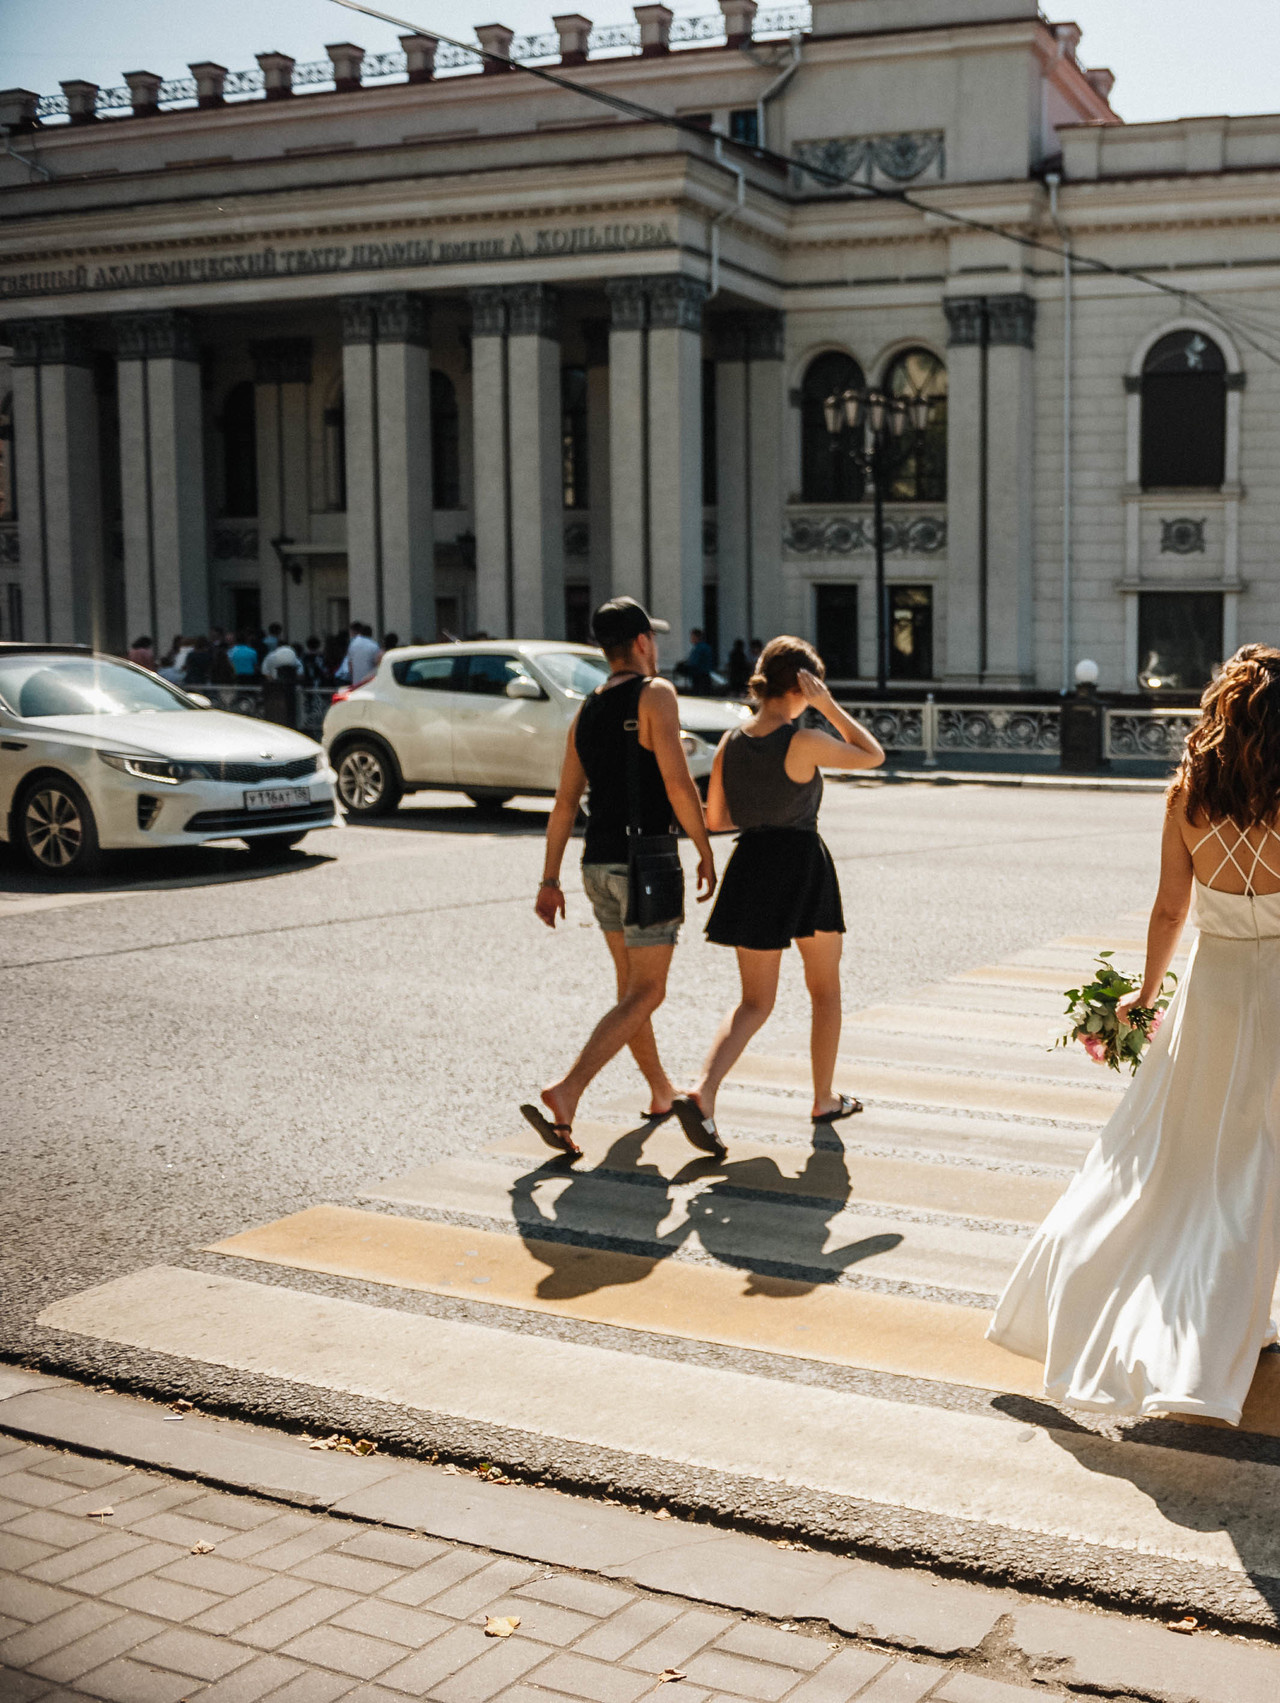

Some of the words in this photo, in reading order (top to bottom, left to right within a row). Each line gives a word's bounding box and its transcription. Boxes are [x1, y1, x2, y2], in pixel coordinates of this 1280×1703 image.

[94, 247, 276, 288] АКАДЕМИЧЕСКИЙ
[280, 246, 346, 274] ТЕАТР
[351, 239, 434, 267] ДРАМЫ
[534, 221, 676, 255] КОЛЬЦОВА
